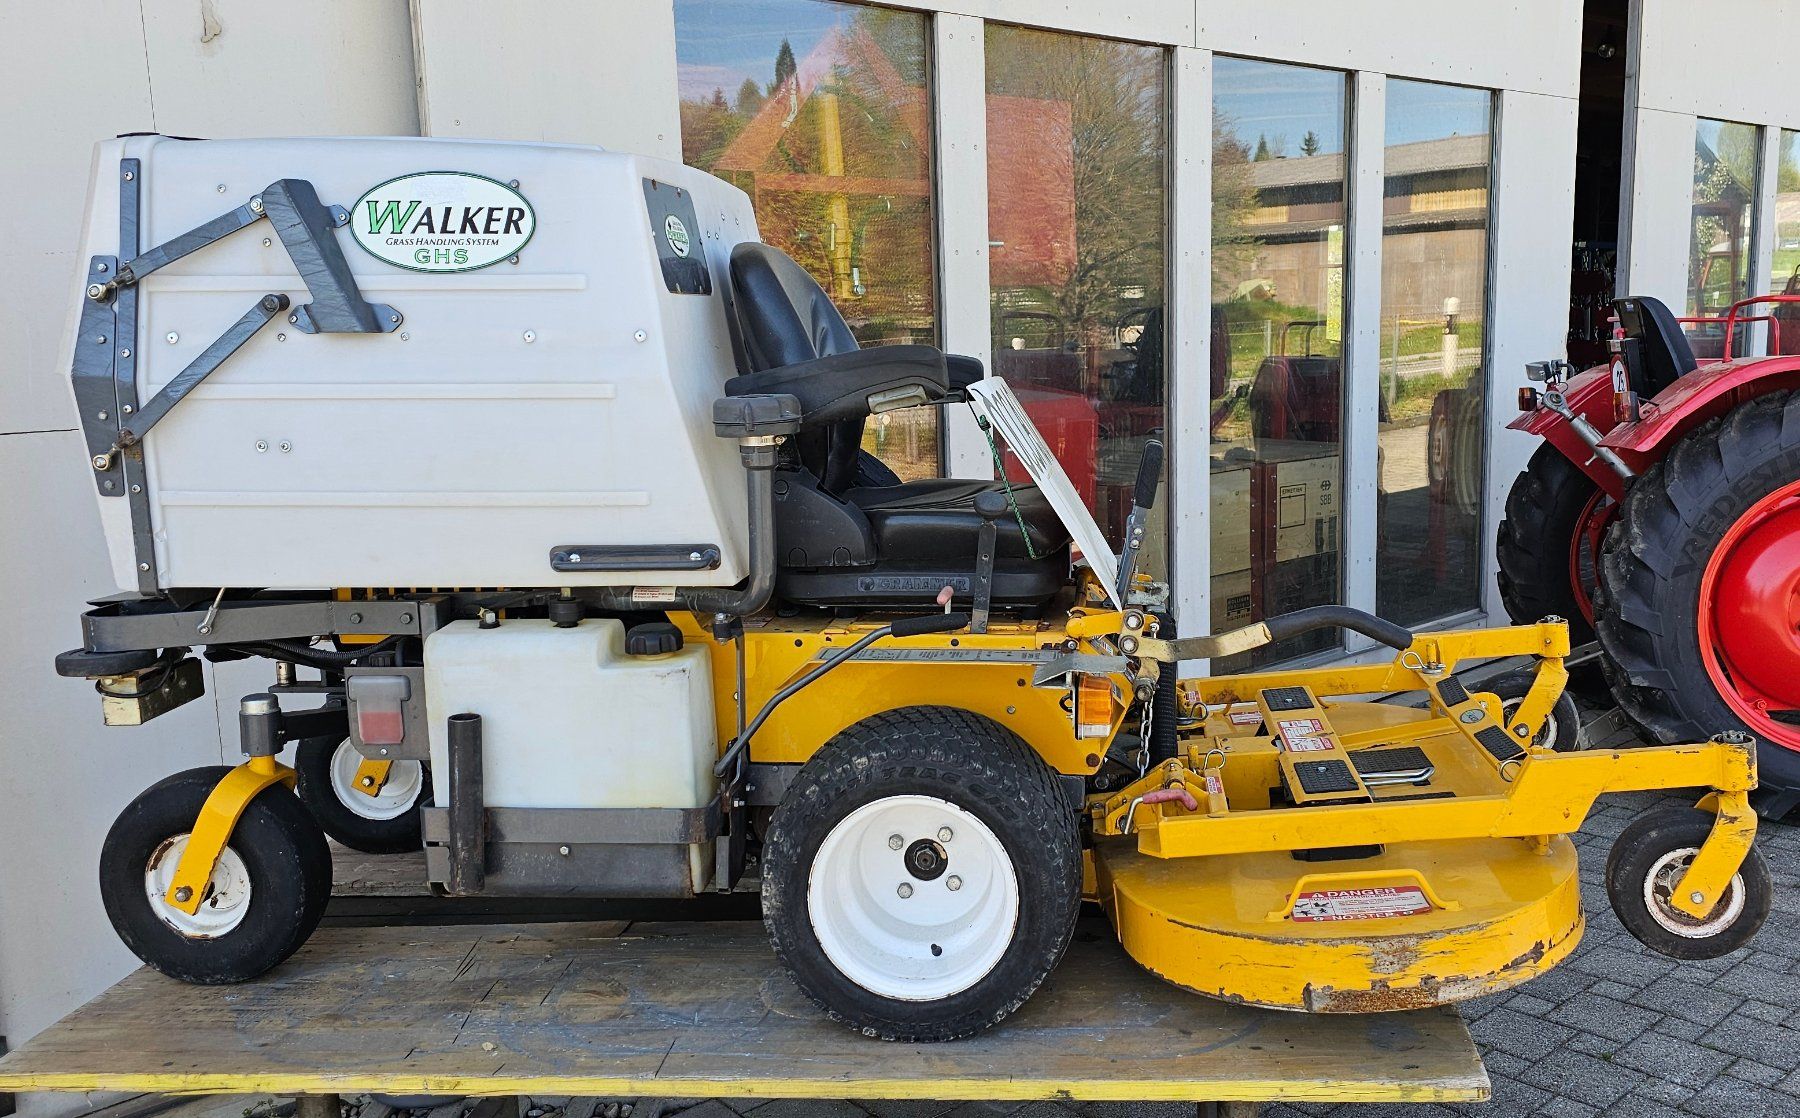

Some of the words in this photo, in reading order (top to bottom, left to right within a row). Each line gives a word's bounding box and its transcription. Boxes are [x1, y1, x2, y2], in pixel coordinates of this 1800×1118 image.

[366, 200, 526, 235] WALKER
[385, 237, 414, 246] GRASS
[415, 237, 465, 246] HANDLING
[466, 237, 499, 246] SYSTEM
[414, 248, 469, 264] GHS
[1320, 493, 1332, 506] SBB
[1327, 888, 1396, 897] DANGER
